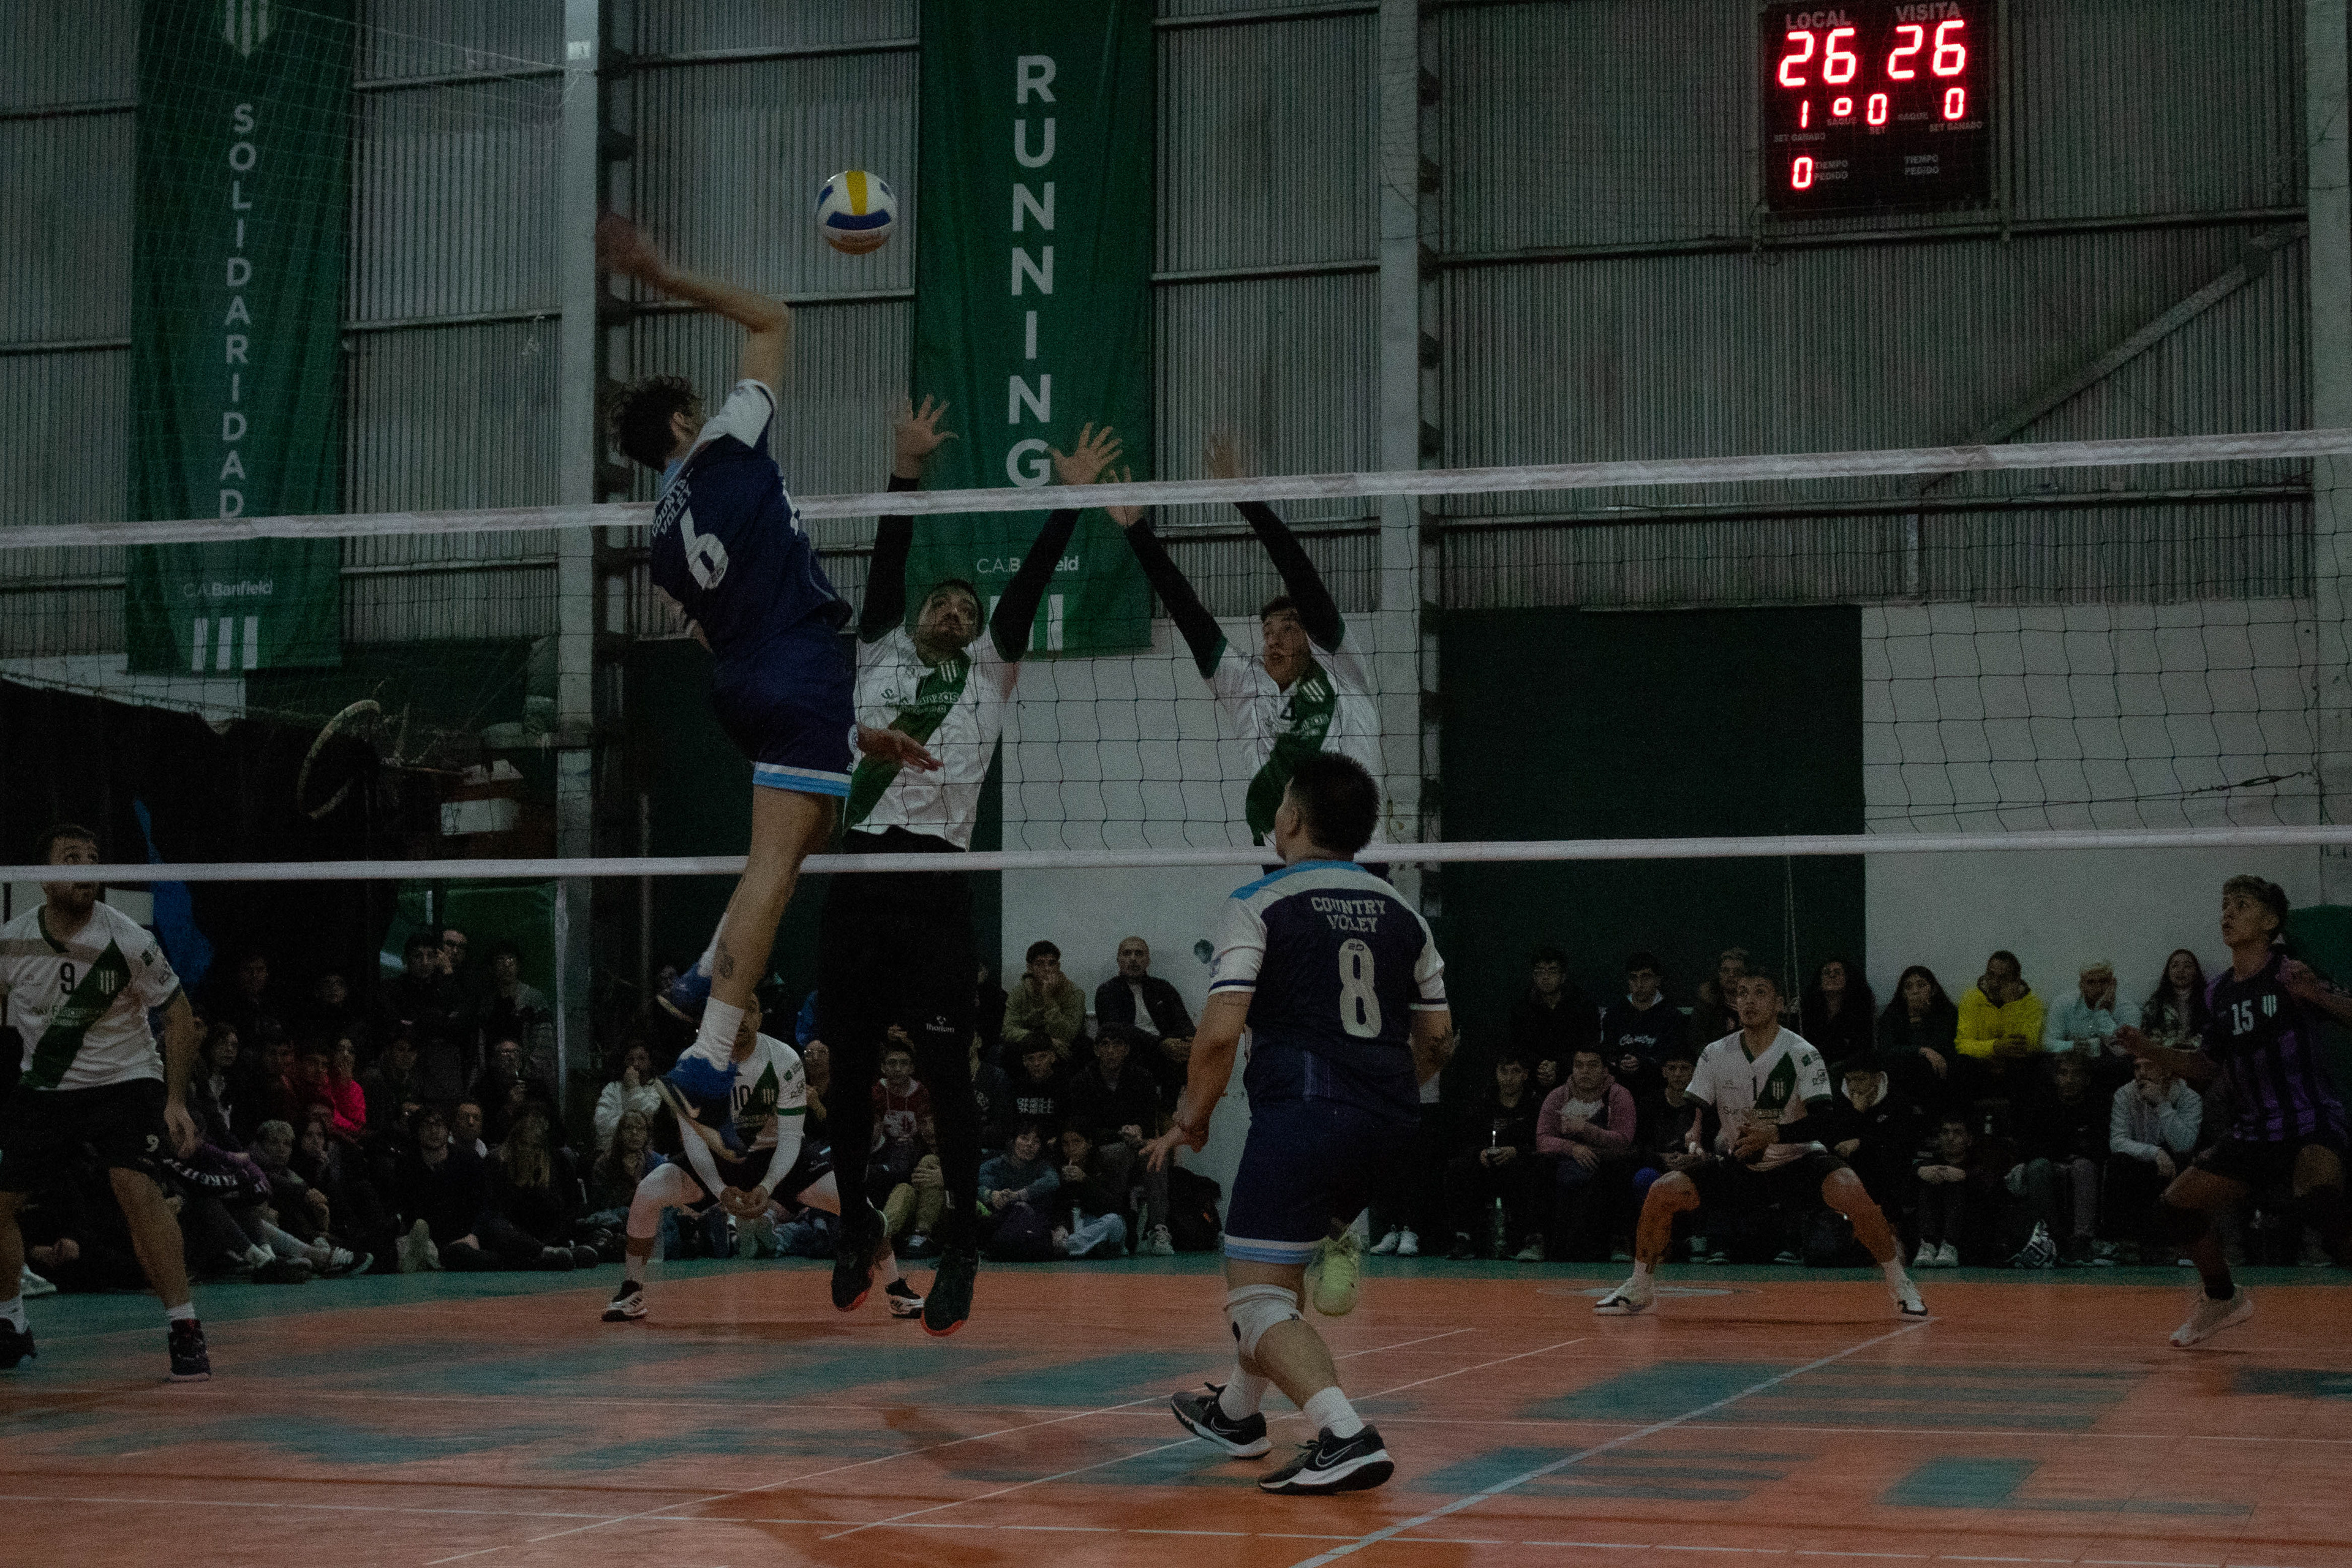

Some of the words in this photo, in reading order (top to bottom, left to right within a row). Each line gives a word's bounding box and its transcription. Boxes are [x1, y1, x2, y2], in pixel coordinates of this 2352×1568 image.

[1785, 9, 1851, 29] LOCAL
[1895, 2, 1961, 21] VISITA
[1779, 27, 1856, 87] 26
[1888, 20, 1966, 80] 26
[1944, 88, 1965, 119] 0
[1792, 157, 1814, 189] 0
[1006, 54, 1057, 488] RUNNING
[219, 103, 257, 519] SOLIDARIDAD
[679, 506, 729, 591] 6
[1311, 897, 1386, 914] COUNTRY
[1326, 914, 1378, 933] VOLEY
[60, 962, 75, 995] 9
[1339, 938, 1382, 1038] 8
[2231, 998, 2255, 1036] 15
[146, 1134, 160, 1153] 9
